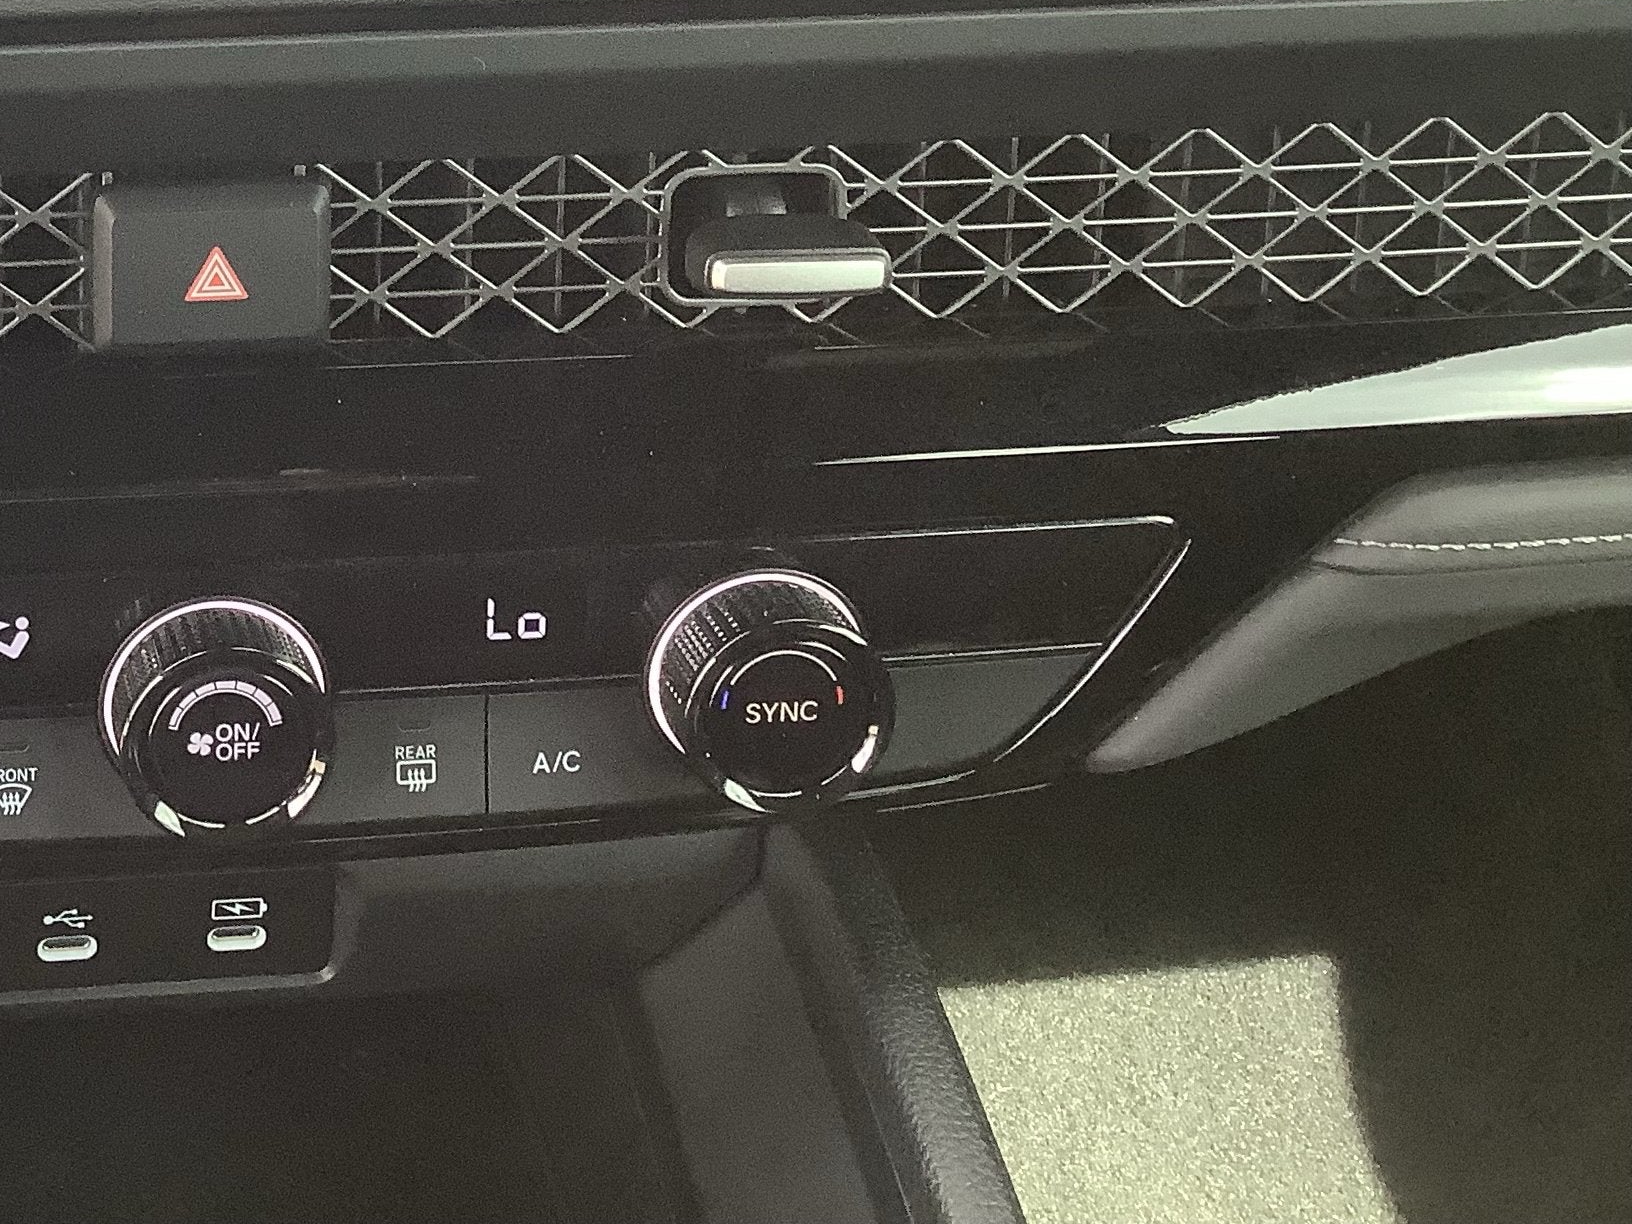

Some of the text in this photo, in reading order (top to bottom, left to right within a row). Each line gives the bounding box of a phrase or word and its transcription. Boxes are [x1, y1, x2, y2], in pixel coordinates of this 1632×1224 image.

[486, 598, 547, 640] Lo
[744, 700, 819, 725] SYNC
[215, 722, 260, 743] ON/
[214, 740, 261, 762] OFF
[394, 745, 437, 760] REAR
[532, 750, 582, 775] A/C
